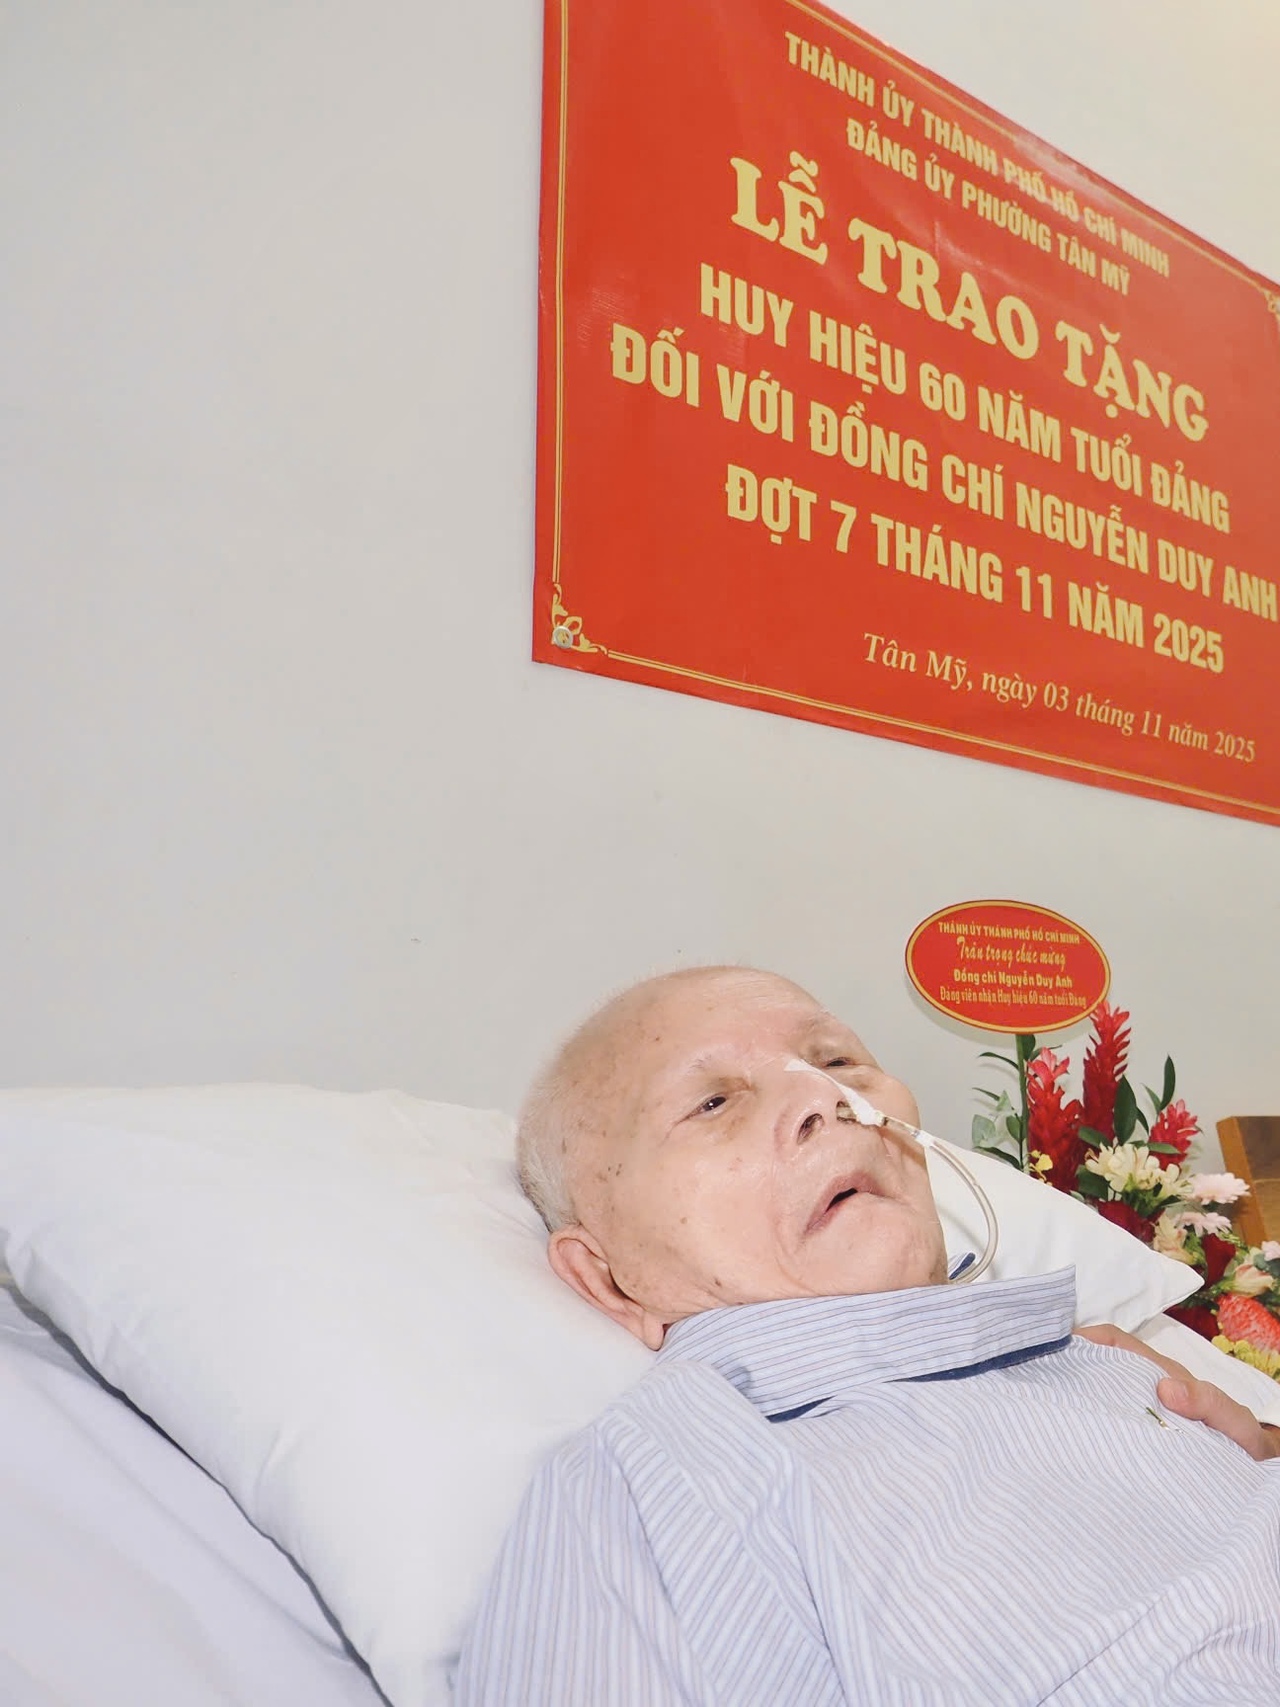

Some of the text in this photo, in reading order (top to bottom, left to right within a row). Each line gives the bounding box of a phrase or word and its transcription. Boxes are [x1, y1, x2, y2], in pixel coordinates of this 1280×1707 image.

[785, 31, 875, 107] THÀNH
[882, 80, 915, 127] ỦY
[921, 108, 999, 177] THÀNH
[1002, 157, 1047, 203] PHỐ
[1082, 206, 1118, 246] CHÍ
[1120, 227, 1170, 278] MINH
[846, 118, 1131, 296] ĐẢNG ỦY PHƯỜNG TÂN MỸ
[700, 262, 1230, 534] HUY HIỆU 60 NĂM TUỔI ĐẢNG
[730, 150, 1209, 442] LỄ TRAO TẶNG
[610, 322, 1278, 622] ĐỐI VỚI ĐỒNG CHÍ NGUYỄN DUY ANH
[725, 463, 1224, 673] ĐỢT 7 THÁNG 11 NĂM 2025
[863, 633, 1256, 762] Tân Mỹ, ngày 03 tháng 11 năm 2025
[1036, 975, 1053, 989] Duy
[1055, 976, 1073, 988] Anh
